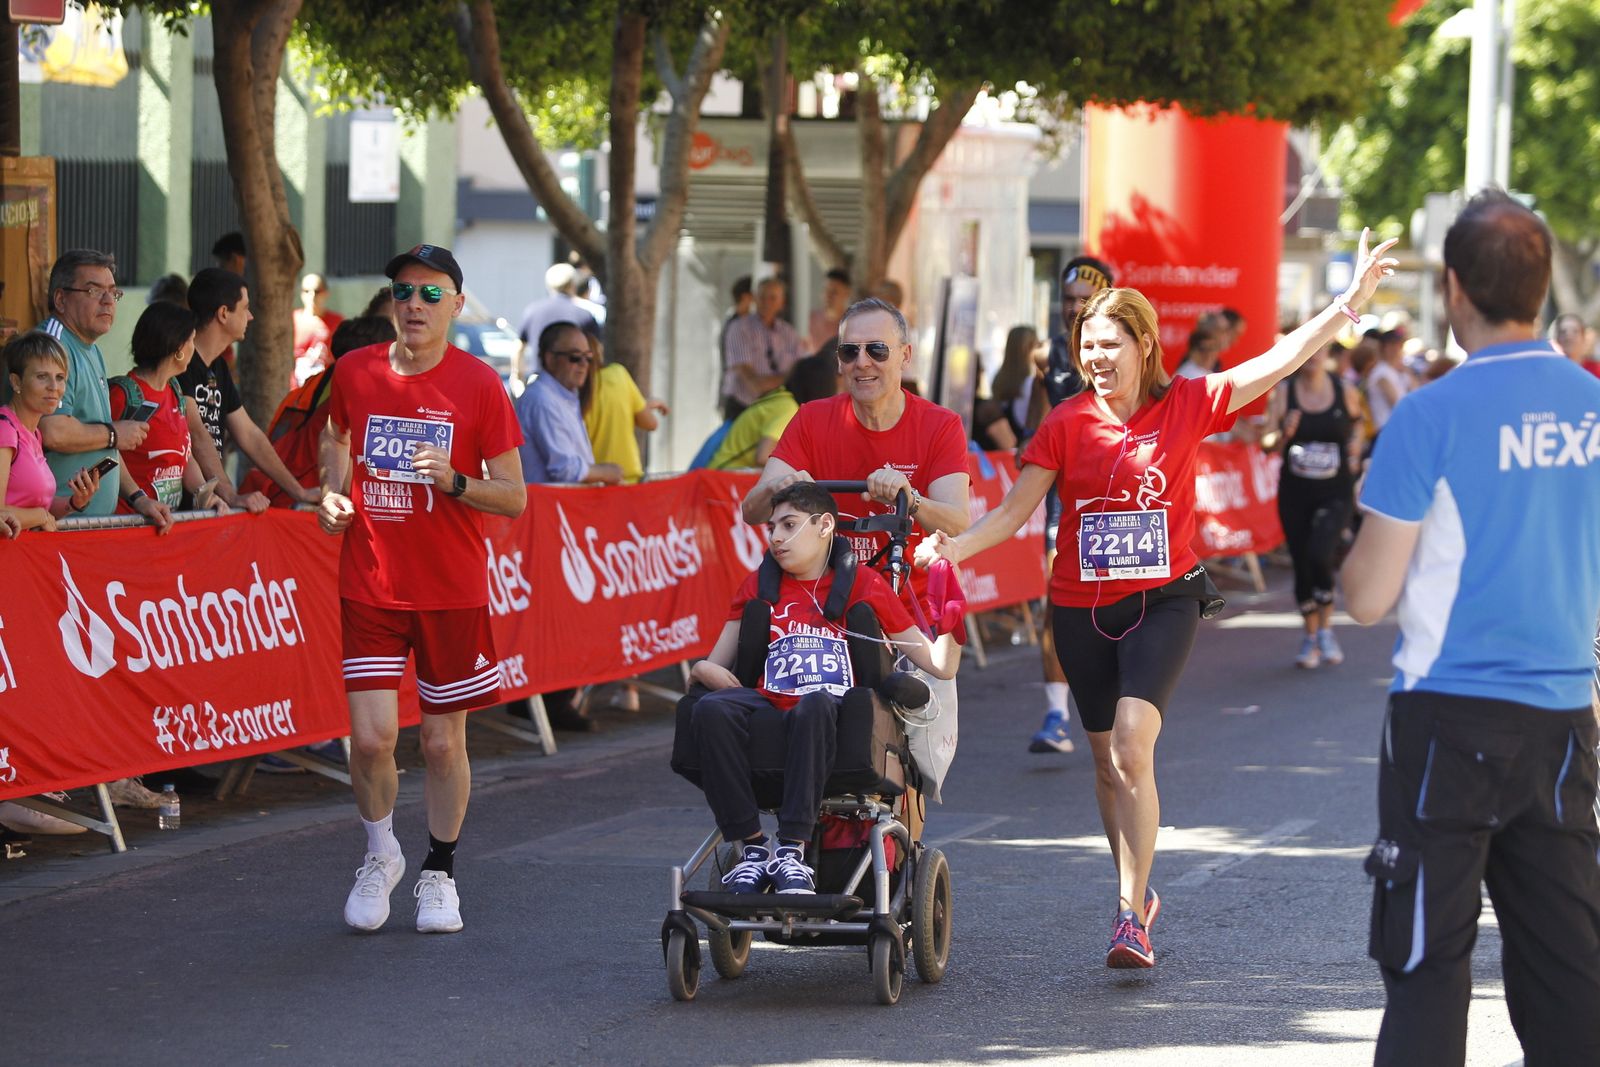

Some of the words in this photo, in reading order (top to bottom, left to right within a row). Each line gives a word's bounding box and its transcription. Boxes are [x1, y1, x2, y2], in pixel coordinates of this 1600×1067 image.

[1123, 261, 1240, 287] Santander
[425, 407, 453, 417] Santander
[1133, 429, 1160, 441] Santander
[371, 436, 434, 460] 205
[891, 462, 919, 470] Santander
[362, 481, 413, 497] CARRERA
[363, 493, 414, 509] SOLIDARIA
[1108, 515, 1141, 523] CARRERA
[1108, 520, 1141, 528] SOLIDARIA
[1088, 531, 1154, 556] 2214
[585, 515, 703, 599] Santander
[1108, 555, 1140, 566] ALVARITO
[106, 561, 305, 673] Santander
[773, 653, 839, 680] 2215
